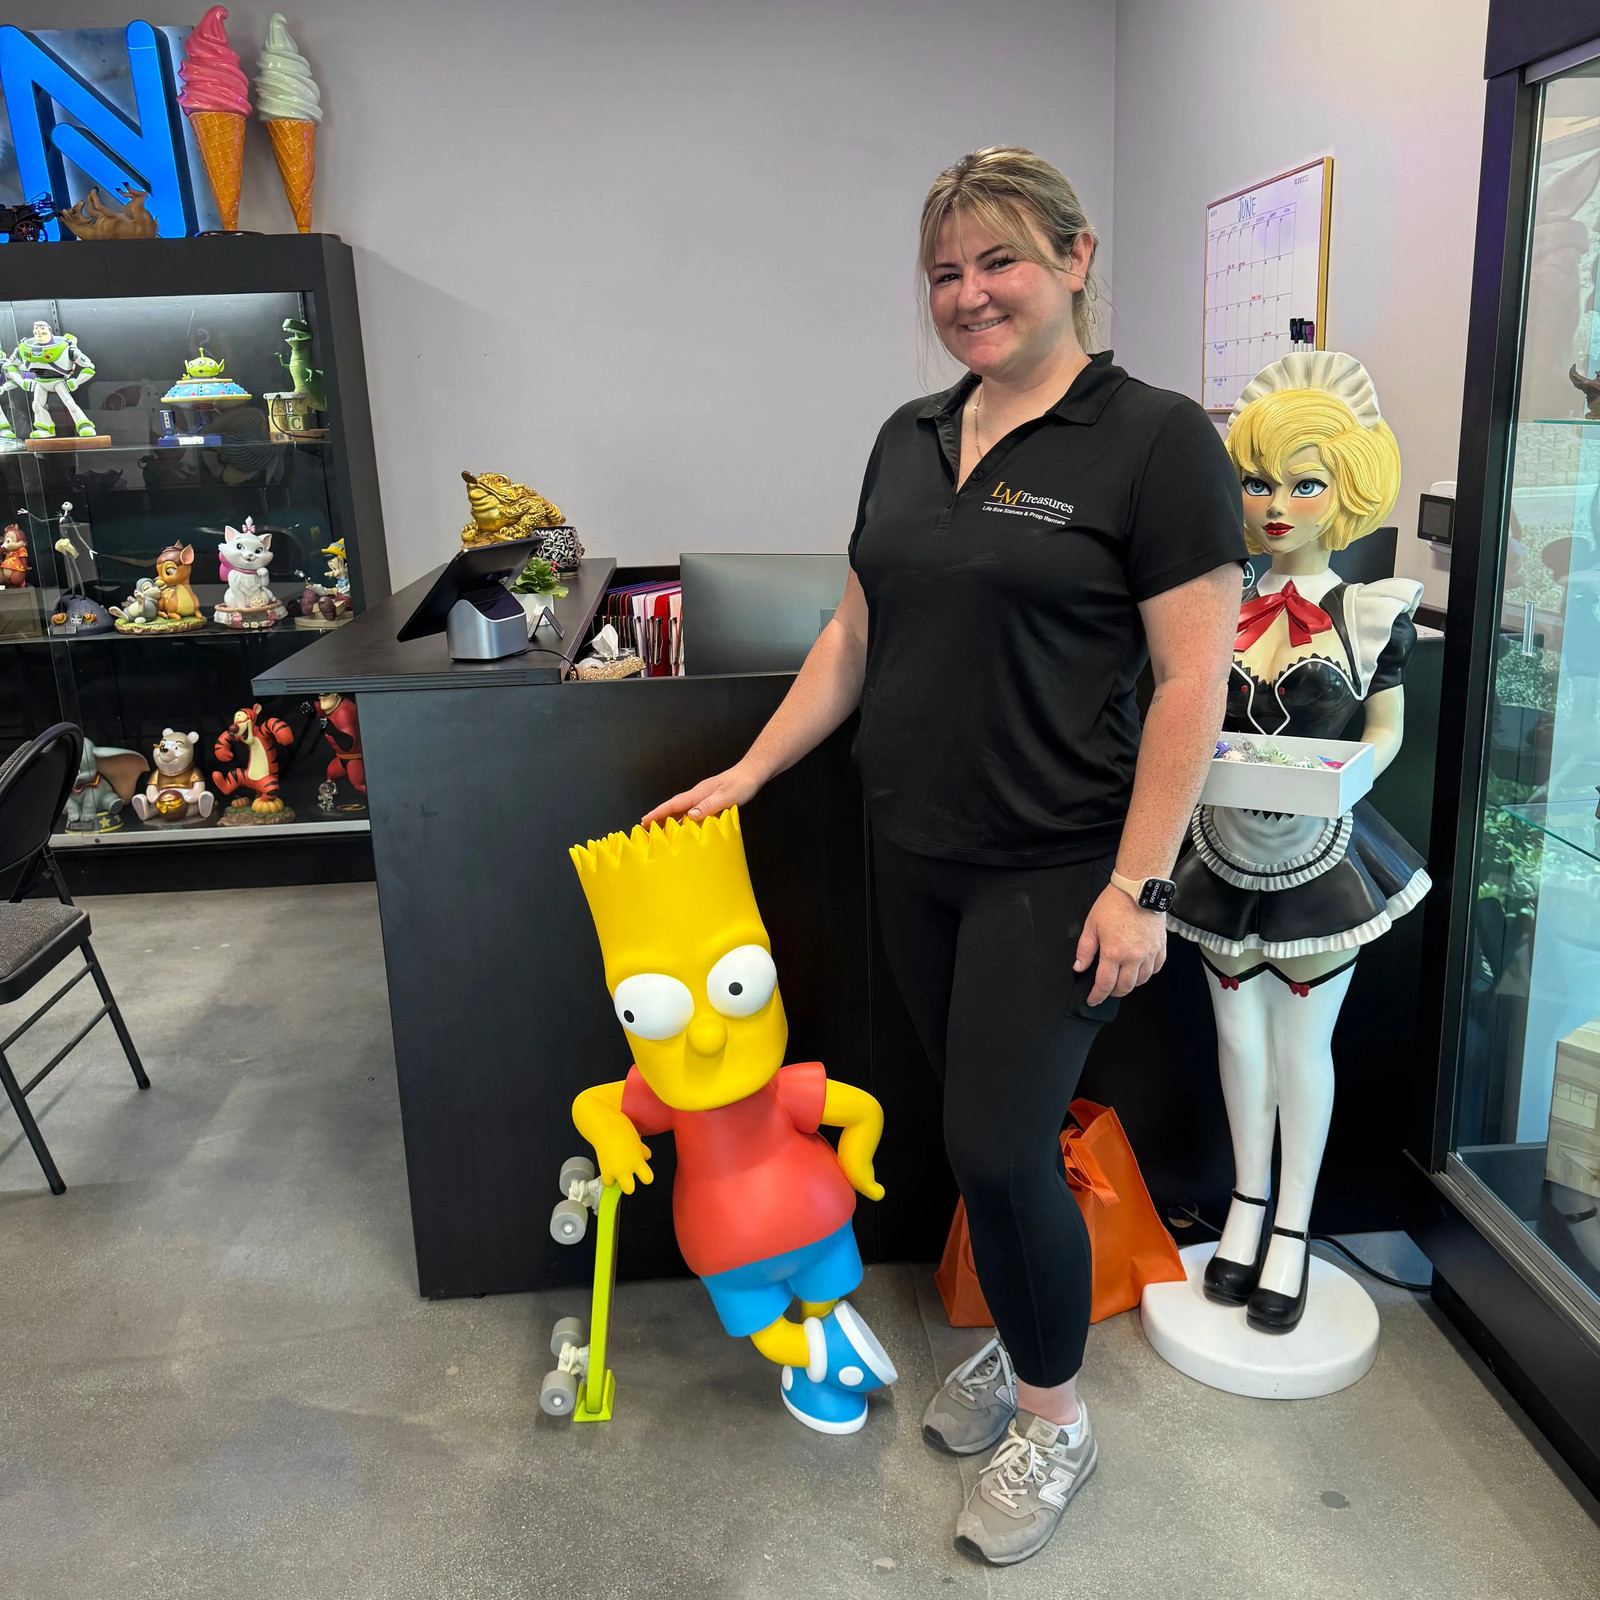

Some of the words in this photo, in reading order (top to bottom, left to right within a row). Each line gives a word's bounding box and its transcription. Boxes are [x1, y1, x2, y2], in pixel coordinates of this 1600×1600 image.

[1238, 196, 1257, 222] JUNE
[1003, 508, 1023, 516] Statues
[1029, 512, 1043, 520] Prop
[1043, 516, 1066, 526] Rentals
